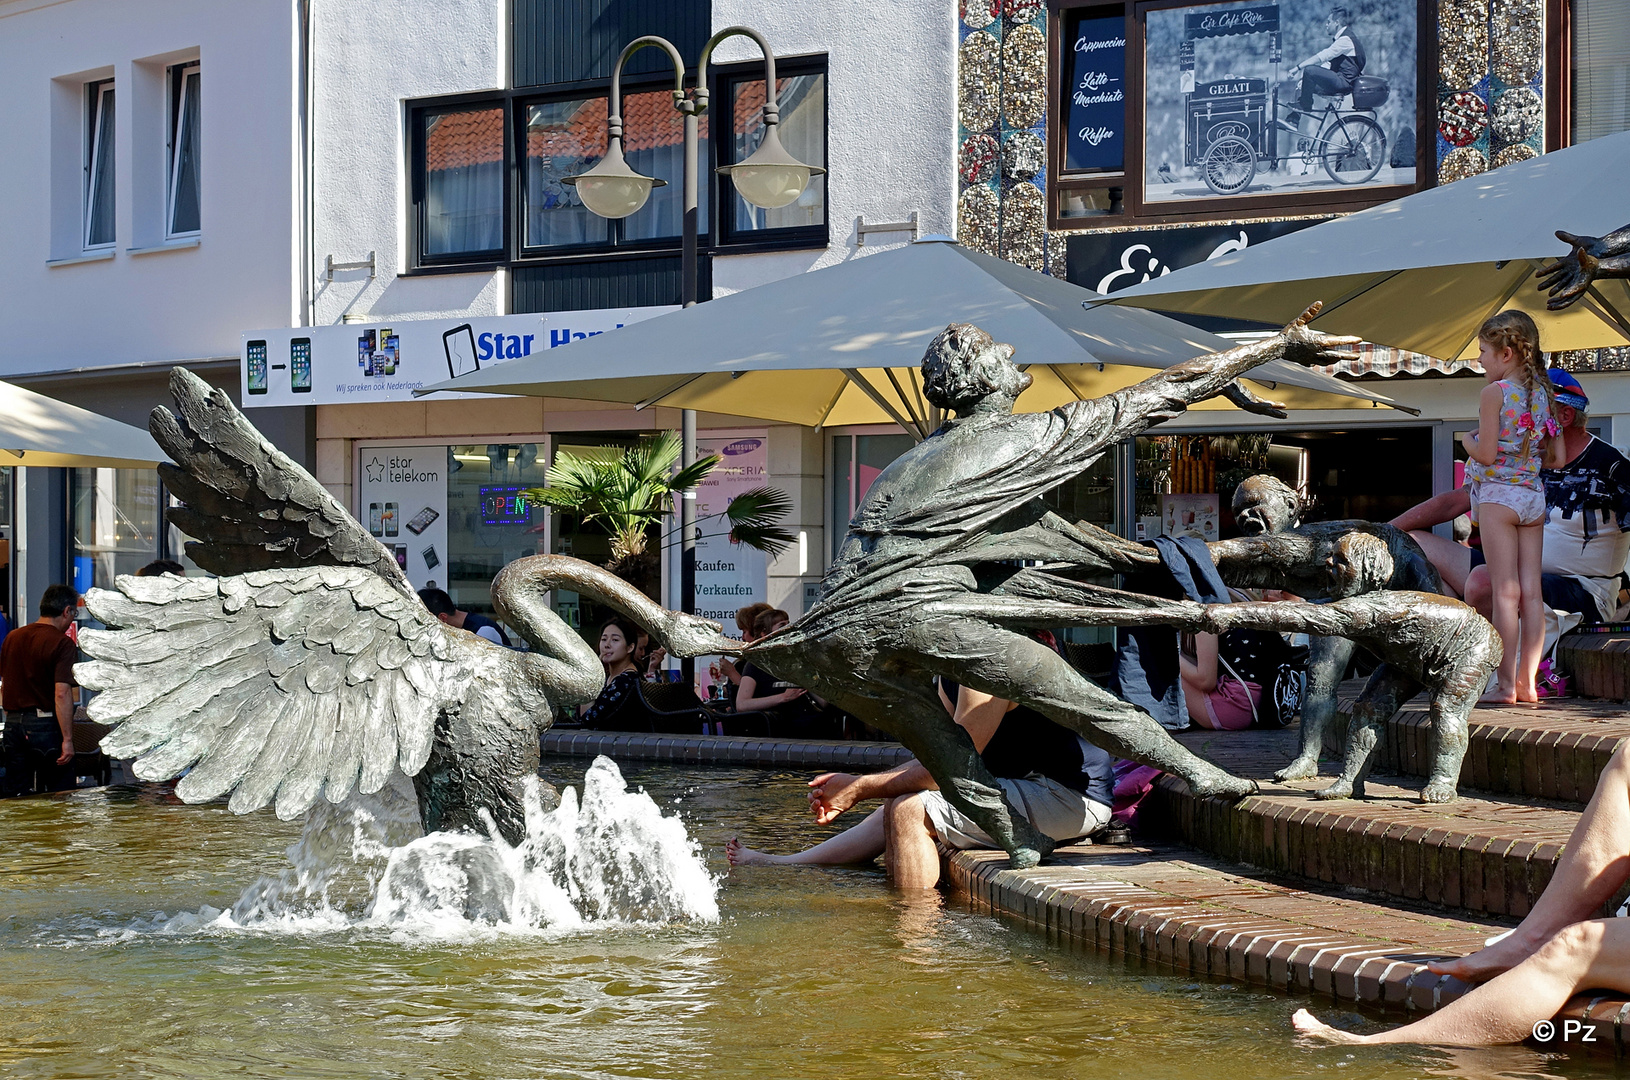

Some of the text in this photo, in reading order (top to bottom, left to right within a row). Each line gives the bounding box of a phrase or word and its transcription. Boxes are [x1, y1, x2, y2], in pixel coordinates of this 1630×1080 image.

[1218, 12, 1240, 28] Café
[1209, 83, 1250, 95] GELATI
[1073, 89, 1124, 107] Macchiato
[1078, 126, 1115, 146] Kaffee
[477, 332, 535, 361] Star
[336, 381, 424, 394] Wij spreken ook Nederlands
[727, 443, 757, 451] SAMSUNG
[389, 455, 413, 469] star
[389, 468, 438, 483] telekom
[724, 466, 765, 475] XPERIA
[485, 496, 525, 515] OPEN
[694, 560, 735, 571] Kaufen
[694, 583, 753, 596] Verkaufen
